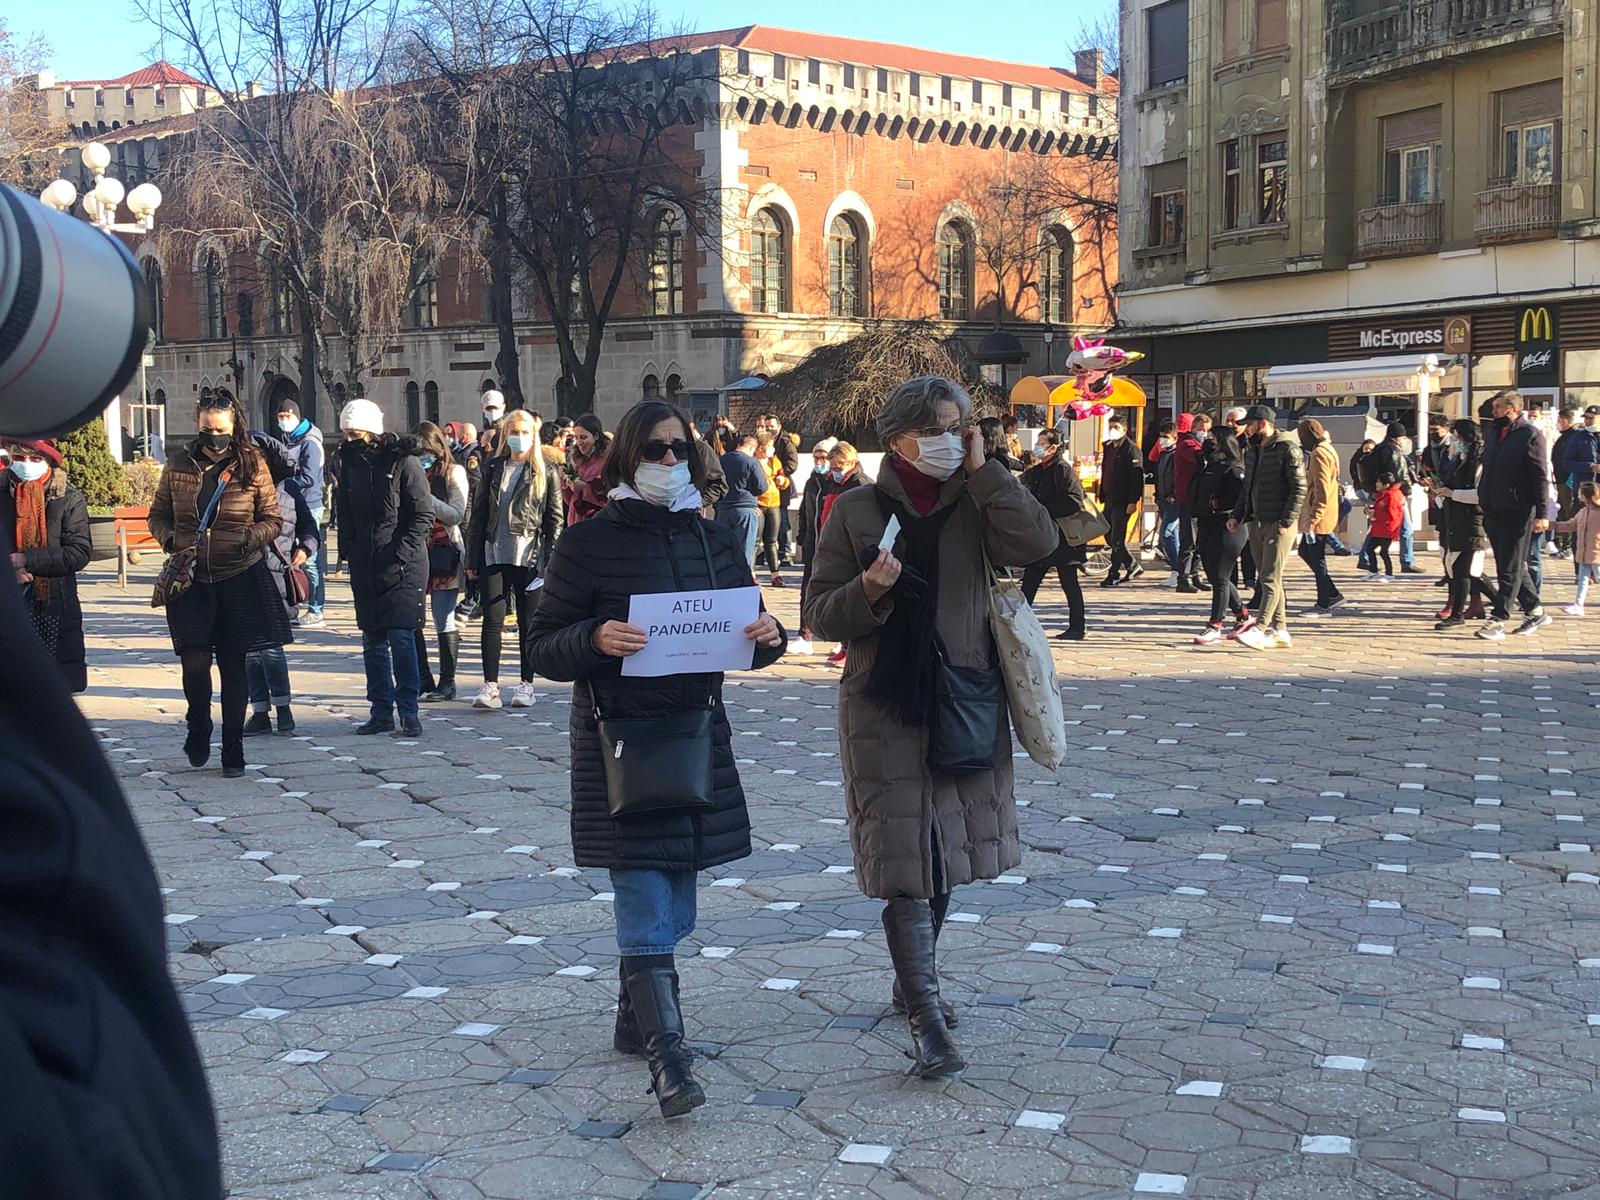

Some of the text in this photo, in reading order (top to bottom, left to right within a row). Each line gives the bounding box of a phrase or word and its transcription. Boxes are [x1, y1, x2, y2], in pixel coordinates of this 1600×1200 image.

[1360, 329, 1443, 350] McExpress
[1454, 327, 1465, 337] 24
[672, 599, 713, 613] ATEU
[648, 621, 732, 637] PANDEMIE
